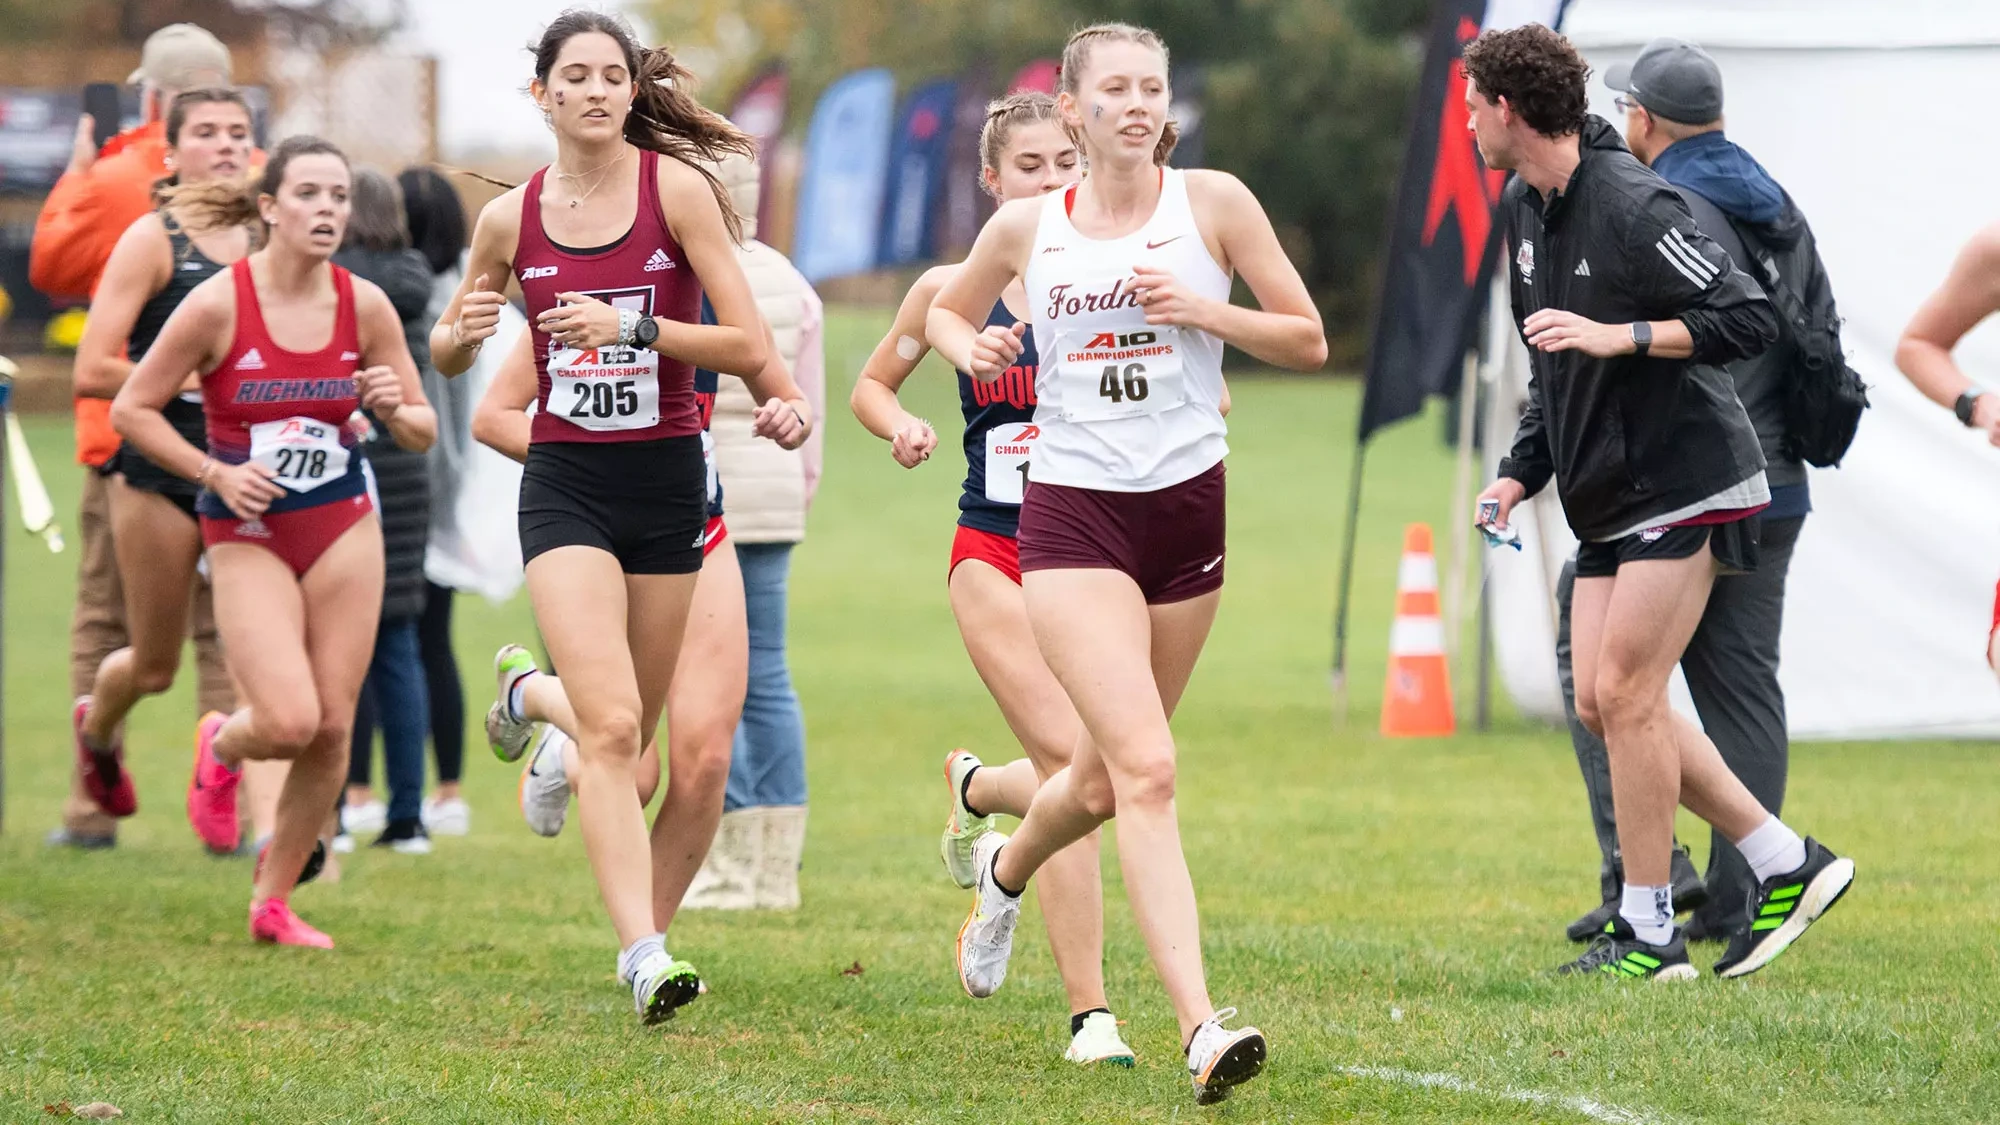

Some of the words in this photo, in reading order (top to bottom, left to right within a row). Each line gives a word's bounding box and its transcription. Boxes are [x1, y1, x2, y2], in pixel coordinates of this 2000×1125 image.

[521, 265, 559, 281] A10
[643, 261, 676, 272] adidas
[1084, 331, 1157, 349] A10
[1067, 345, 1174, 362] CHAMPIONSHIPS
[556, 366, 651, 378] CHAMPIONSHIPS
[1099, 362, 1149, 403] 46
[570, 381, 638, 418] 205
[275, 448, 328, 479] 278
